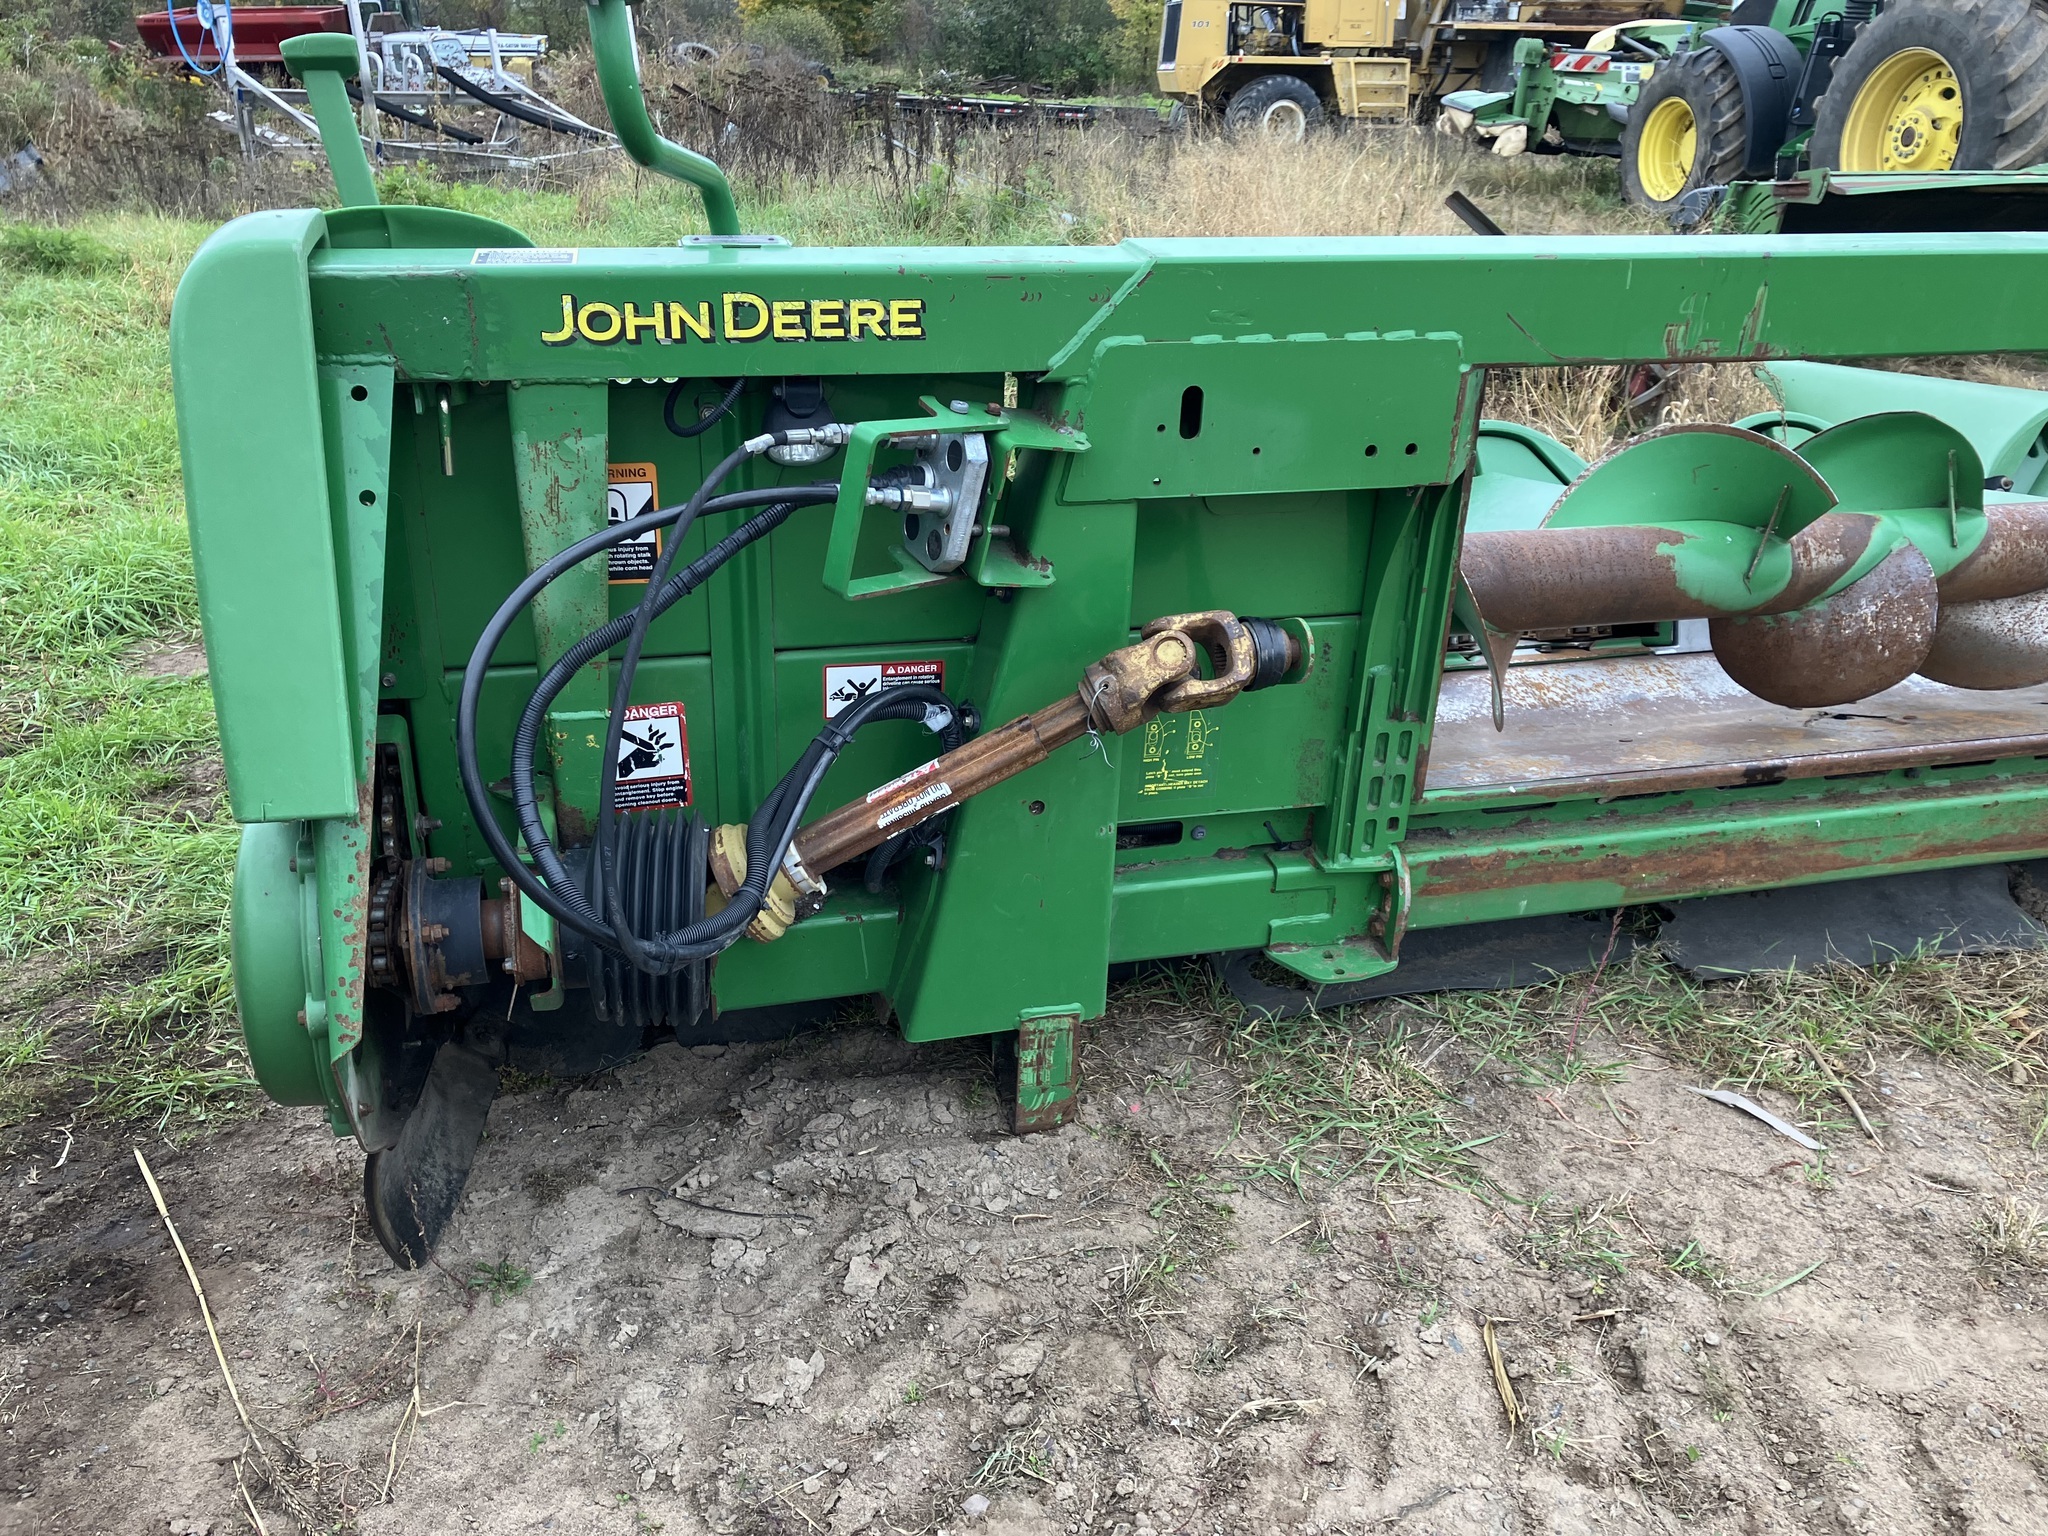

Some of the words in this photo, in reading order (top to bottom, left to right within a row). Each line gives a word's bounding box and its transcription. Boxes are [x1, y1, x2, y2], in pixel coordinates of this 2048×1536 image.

[541, 294, 714, 346] JOHN
[722, 292, 926, 344] DEERE
[608, 467, 647, 478] RNING
[897, 664, 938, 674] DANGER
